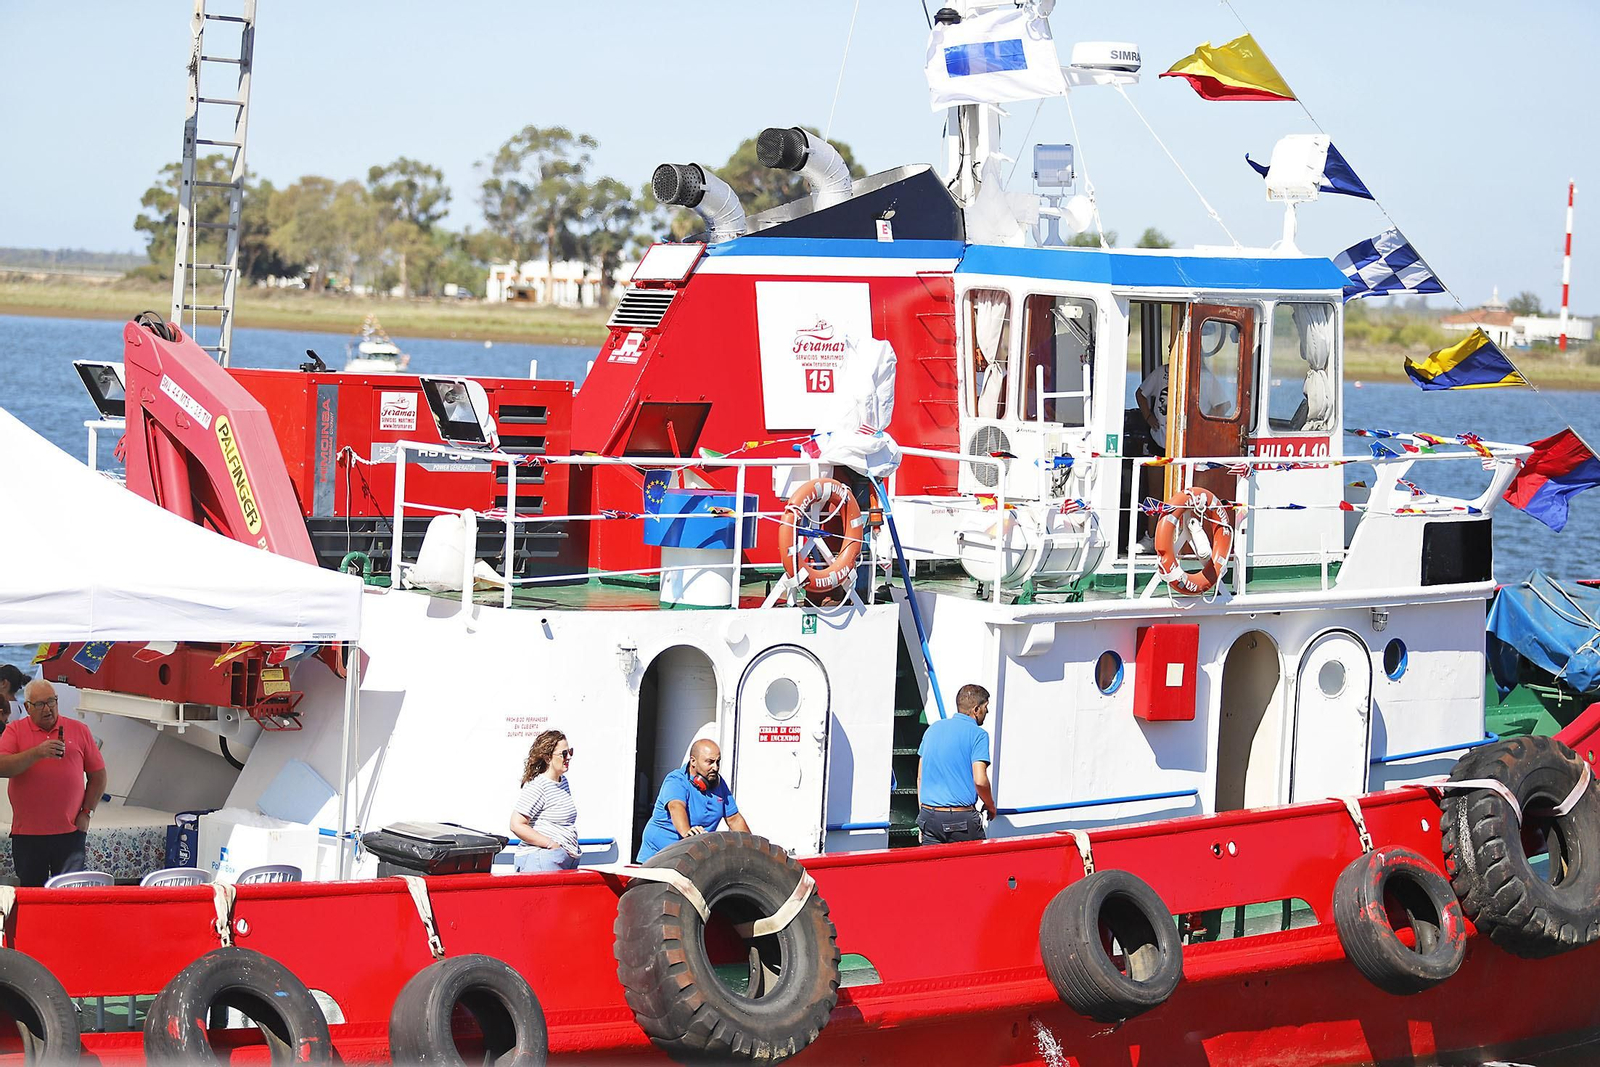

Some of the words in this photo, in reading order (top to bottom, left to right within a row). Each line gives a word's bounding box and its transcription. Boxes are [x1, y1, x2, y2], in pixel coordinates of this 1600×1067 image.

[793, 339, 845, 353] Feramar
[808, 369, 831, 391] 15
[381, 409, 416, 417] Feramar
[320, 398, 330, 483] HIMOINSA
[218, 422, 258, 527] PALFINGER
